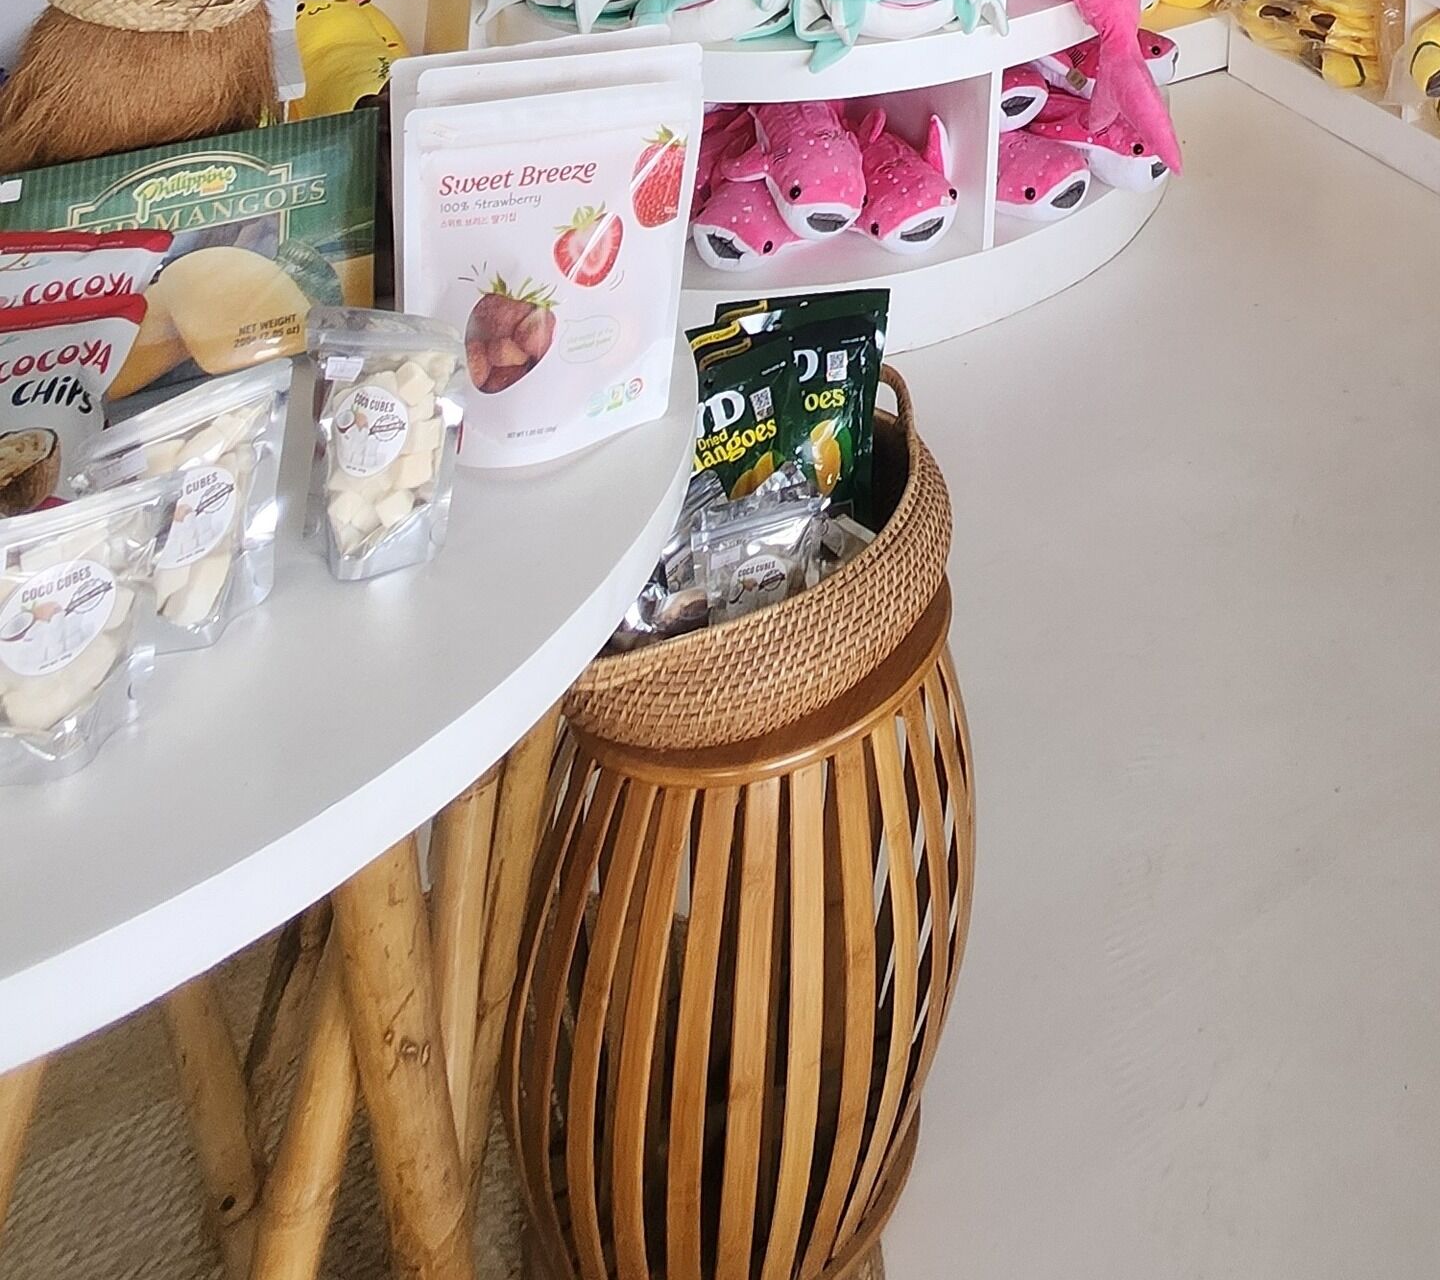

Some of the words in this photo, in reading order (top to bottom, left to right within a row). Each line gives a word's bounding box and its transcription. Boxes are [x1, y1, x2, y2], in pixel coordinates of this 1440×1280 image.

[133, 165, 237, 223] Philippine
[439, 168, 515, 196] Sweet
[518, 162, 597, 188] Breeze
[154, 180, 327, 231] MANGOES
[440, 201, 470, 214] 100%
[474, 192, 542, 211] Strawberry
[23, 272, 133, 306] COCOYA
[238, 323, 257, 335] NET
[259, 313, 296, 331] WEIGHT
[0, 339, 112, 384] COCOYA
[369, 399, 395, 412] CUBES
[693, 418, 778, 472] angoes
[697, 431, 728, 451] Dried
[186, 472, 218, 495] CUBES
[22, 583, 53, 603] COCO
[57, 566, 92, 591] CUBES
[738, 566, 754, 577] COCO
